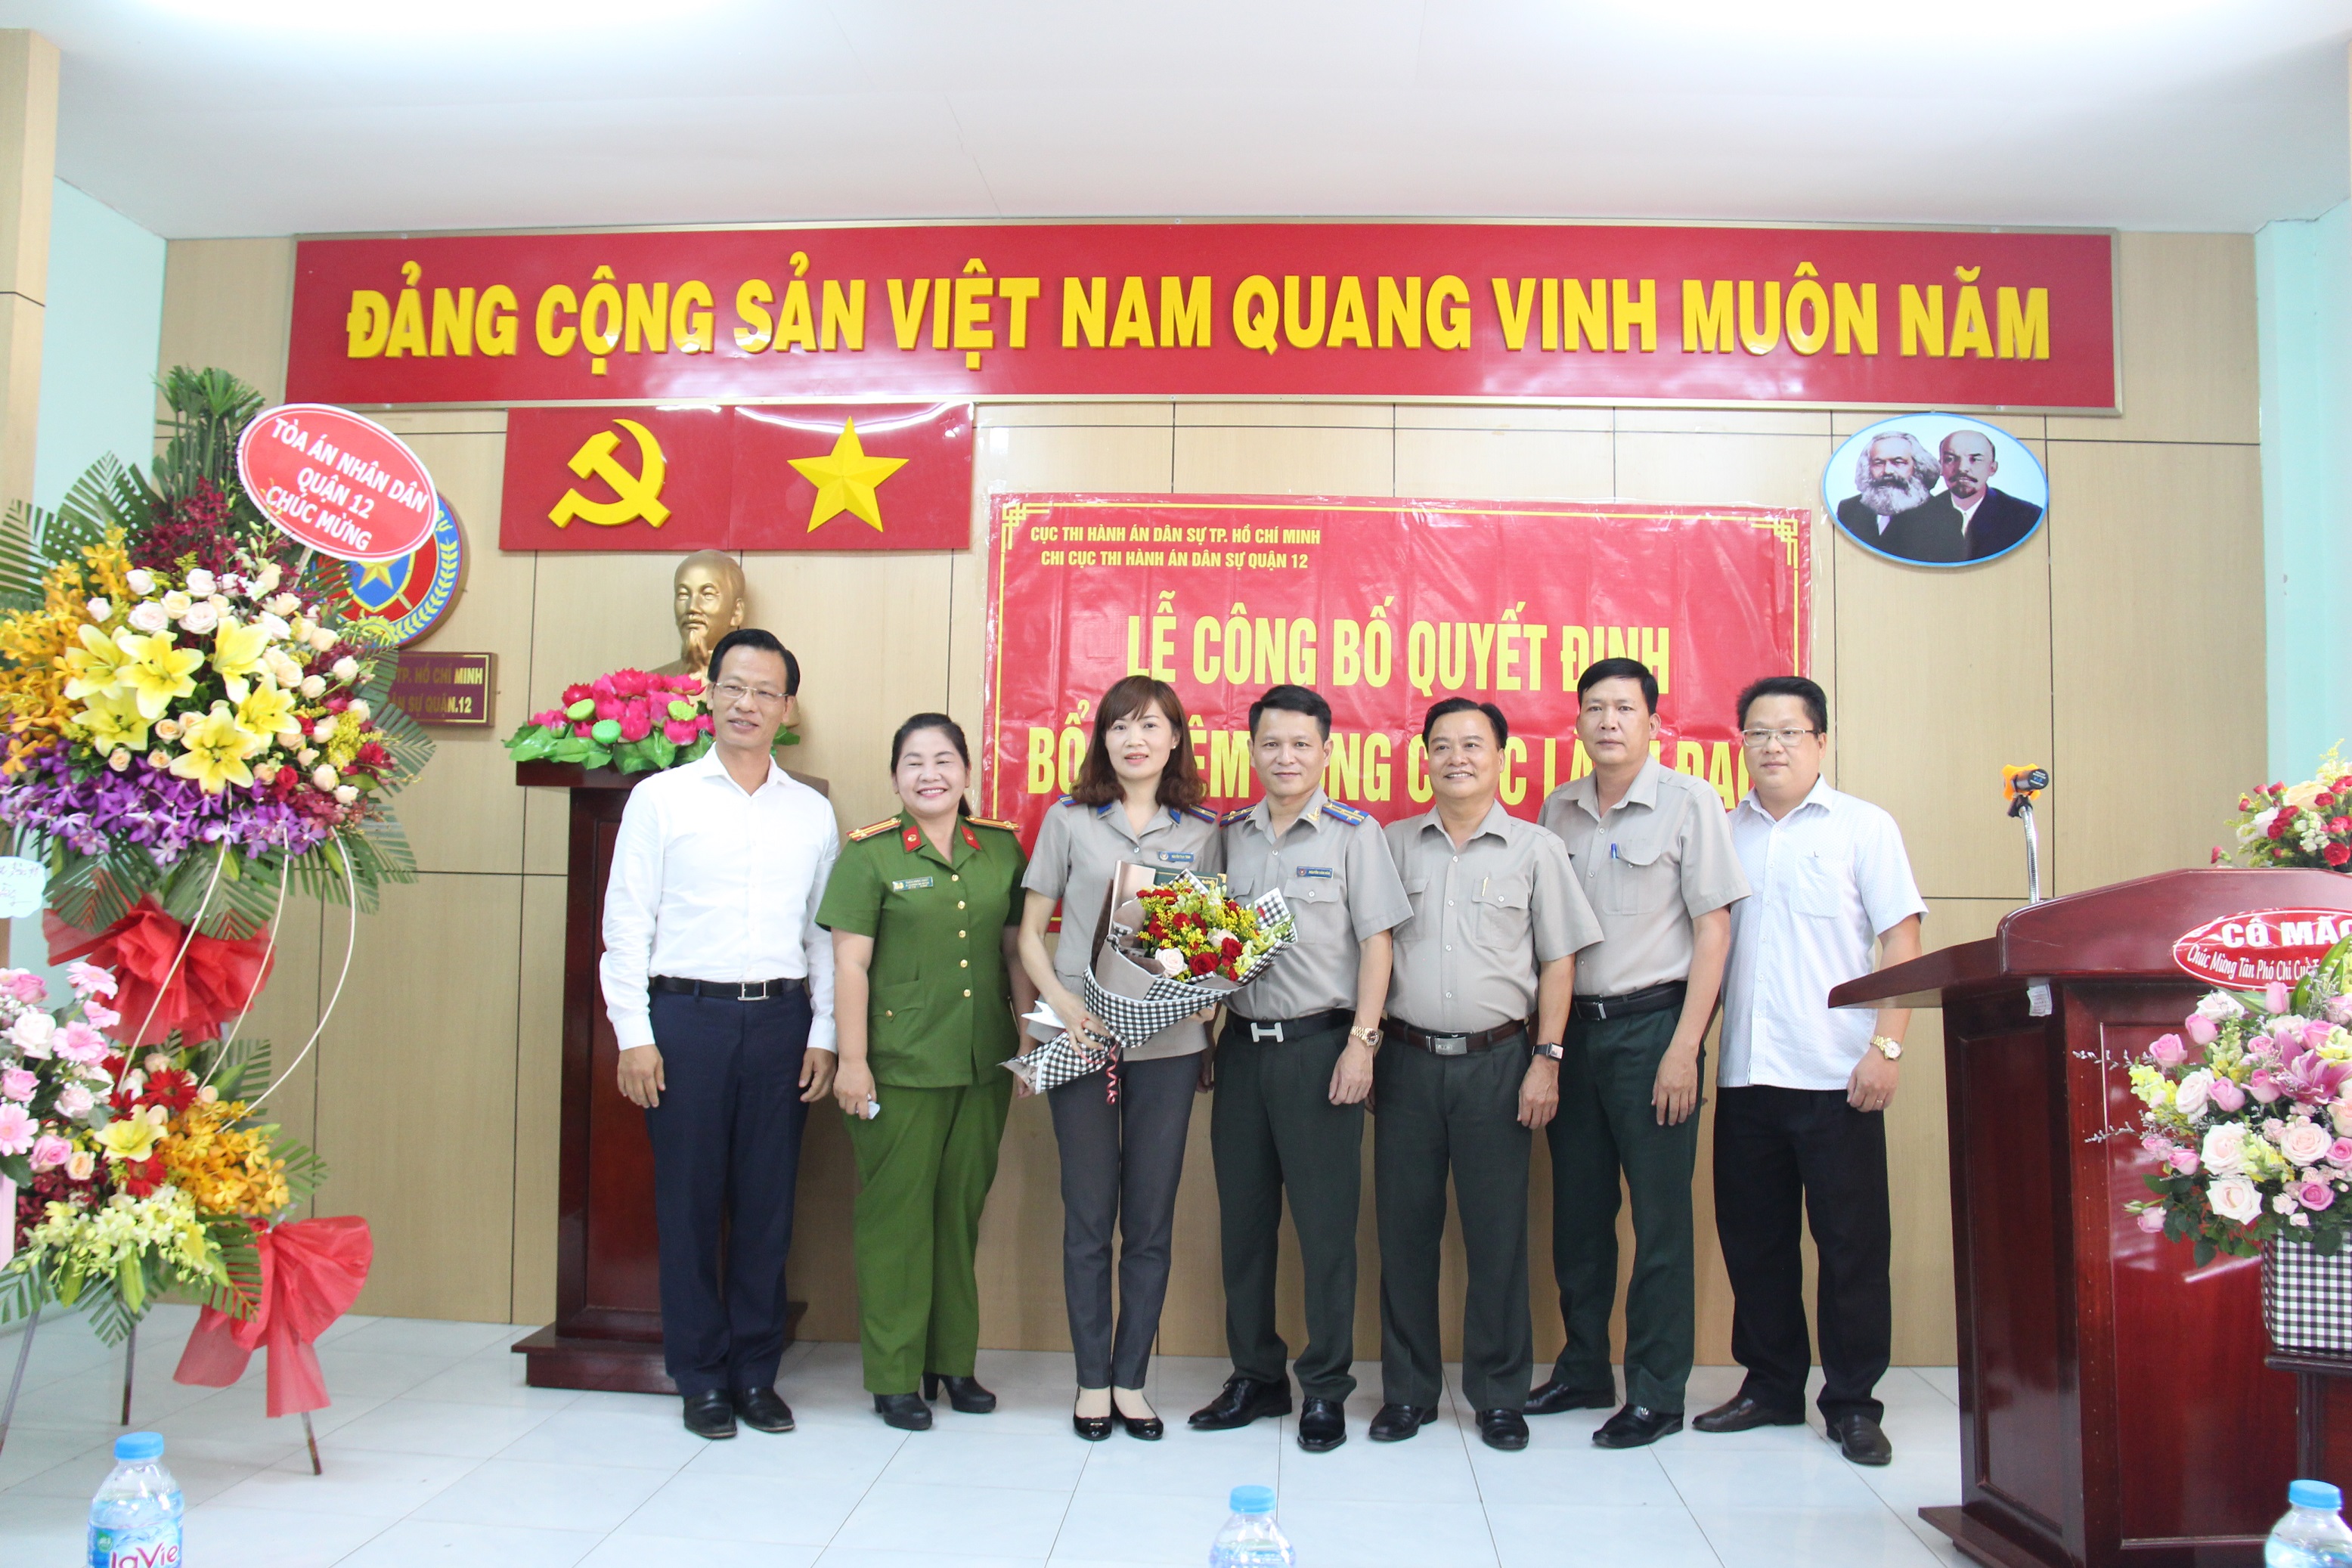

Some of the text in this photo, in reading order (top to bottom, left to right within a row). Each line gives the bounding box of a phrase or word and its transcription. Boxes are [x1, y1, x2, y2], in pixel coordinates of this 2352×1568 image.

[347, 251, 2050, 376] ĐẢNG CỘNG SẢN VIỆT NAM QUANG VINH MUÔN NĂM
[271, 417, 429, 513] TÒA ÁN NHÂN DÂN
[265, 485, 373, 551] CHÚC MỪNG
[297, 467, 375, 519] QUẬN 12
[1030, 525, 1058, 544] CỤC
[1062, 526, 1084, 541] THI
[1087, 524, 1126, 542] HÀNH
[1130, 524, 1150, 542] ÁN
[1153, 524, 1183, 542] DÂN
[1186, 526, 1207, 546] SỰ
[1209, 528, 1228, 543] TP.
[1255, 525, 1279, 544] CHÍ
[1282, 529, 1321, 544] MINH
[1041, 548, 1309, 571] CHI CỤC THI HÀNH ÁN DÂN SỰ QUẬN 12
[1127, 590, 1177, 683] LỄ
[1193, 602, 1318, 686] CÔNG
[1333, 596, 1393, 688] BỐ
[1408, 601, 1548, 697] QUYẾT
[454, 666, 483, 684] MINH
[1027, 699, 1089, 795] BỔ
[2221, 916, 2269, 948] CÔ
[2187, 944, 2211, 969] Chúc
[2238, 956, 2254, 978] Tân
[2257, 959, 2273, 980] Phó
[2276, 959, 2292, 981] Chi
